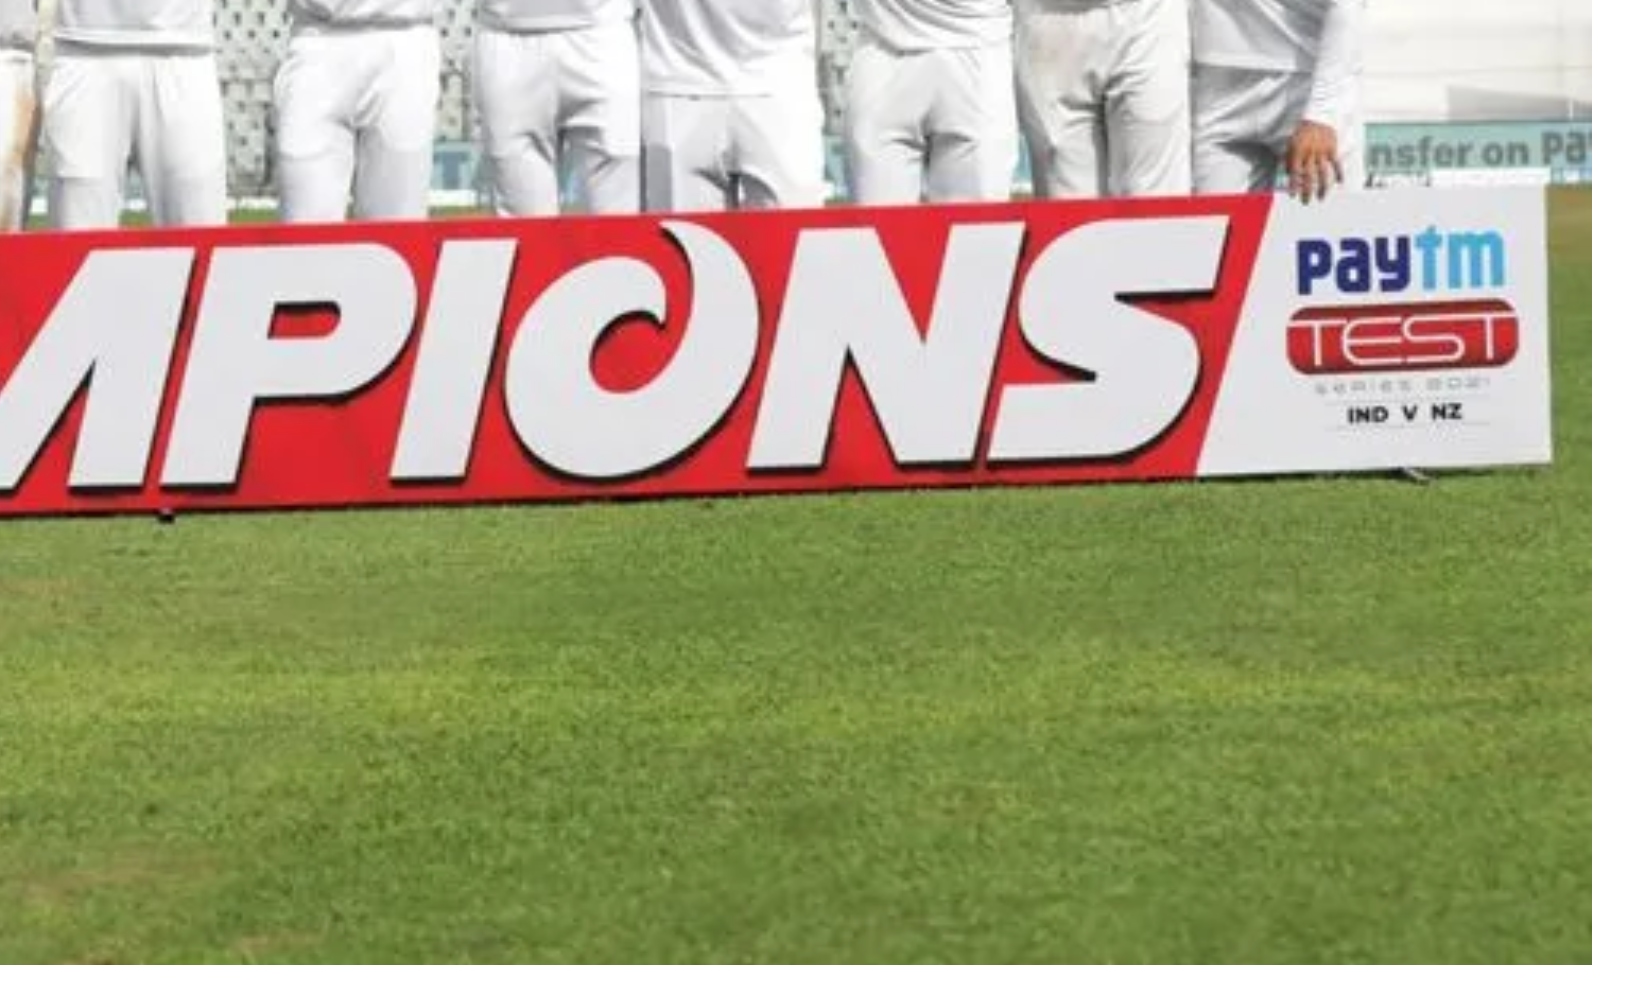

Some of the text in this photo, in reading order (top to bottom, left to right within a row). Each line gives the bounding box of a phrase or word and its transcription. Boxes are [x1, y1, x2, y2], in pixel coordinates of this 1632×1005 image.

[1482, 141, 1530, 166] on
[1541, 130, 1592, 166] Pa
[1287, 311, 1518, 367] TEST
[1347, 403, 1462, 424] IND V NZ
